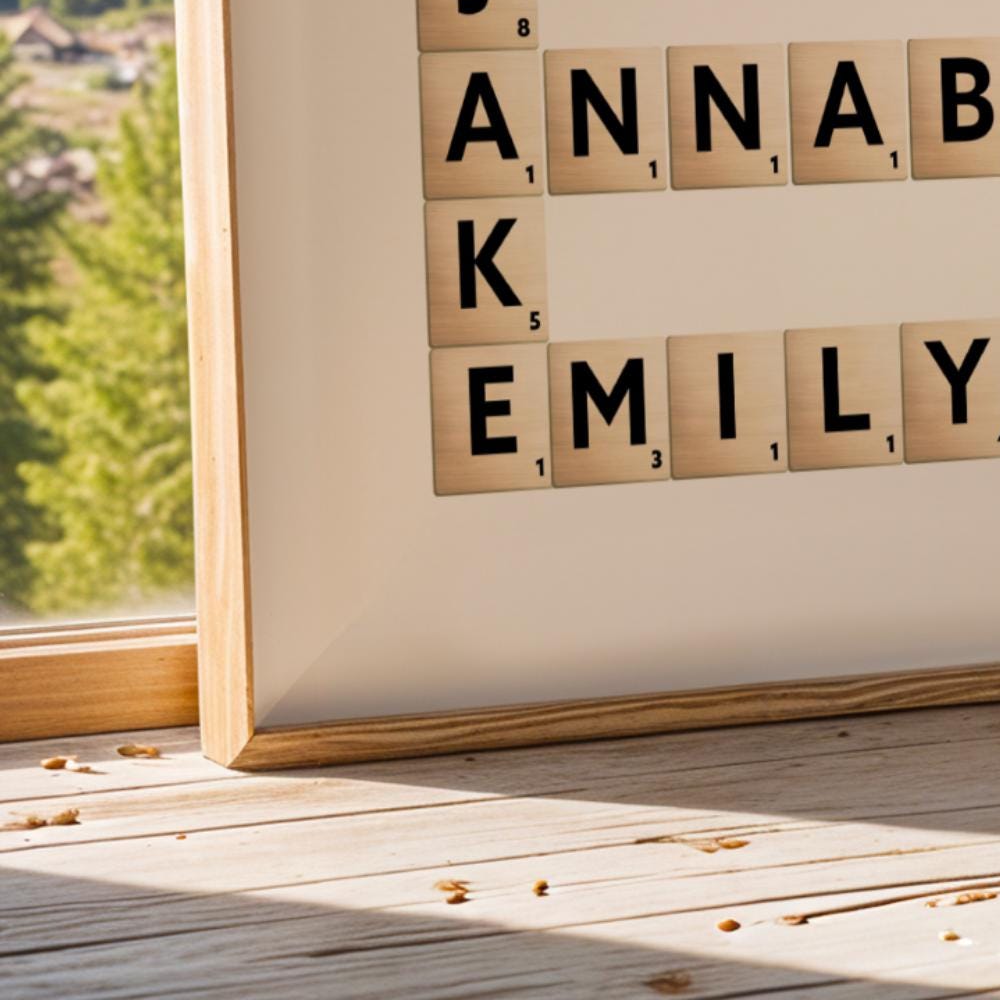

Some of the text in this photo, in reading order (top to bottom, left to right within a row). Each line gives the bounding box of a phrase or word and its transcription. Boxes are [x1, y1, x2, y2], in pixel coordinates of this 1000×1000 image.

[517, 18, 530, 37] 8
[770, 155, 778, 173] 1
[890, 151, 898, 168] 1
[526, 165, 534, 183] 1
[649, 161, 657, 178] 1
[530, 311, 541, 330] 5
[468, 338, 990, 456] EMILY
[770, 442, 779, 460] 1
[886, 435, 894, 453] 1
[536, 458, 544, 476] 1
[652, 450, 662, 469] 3
